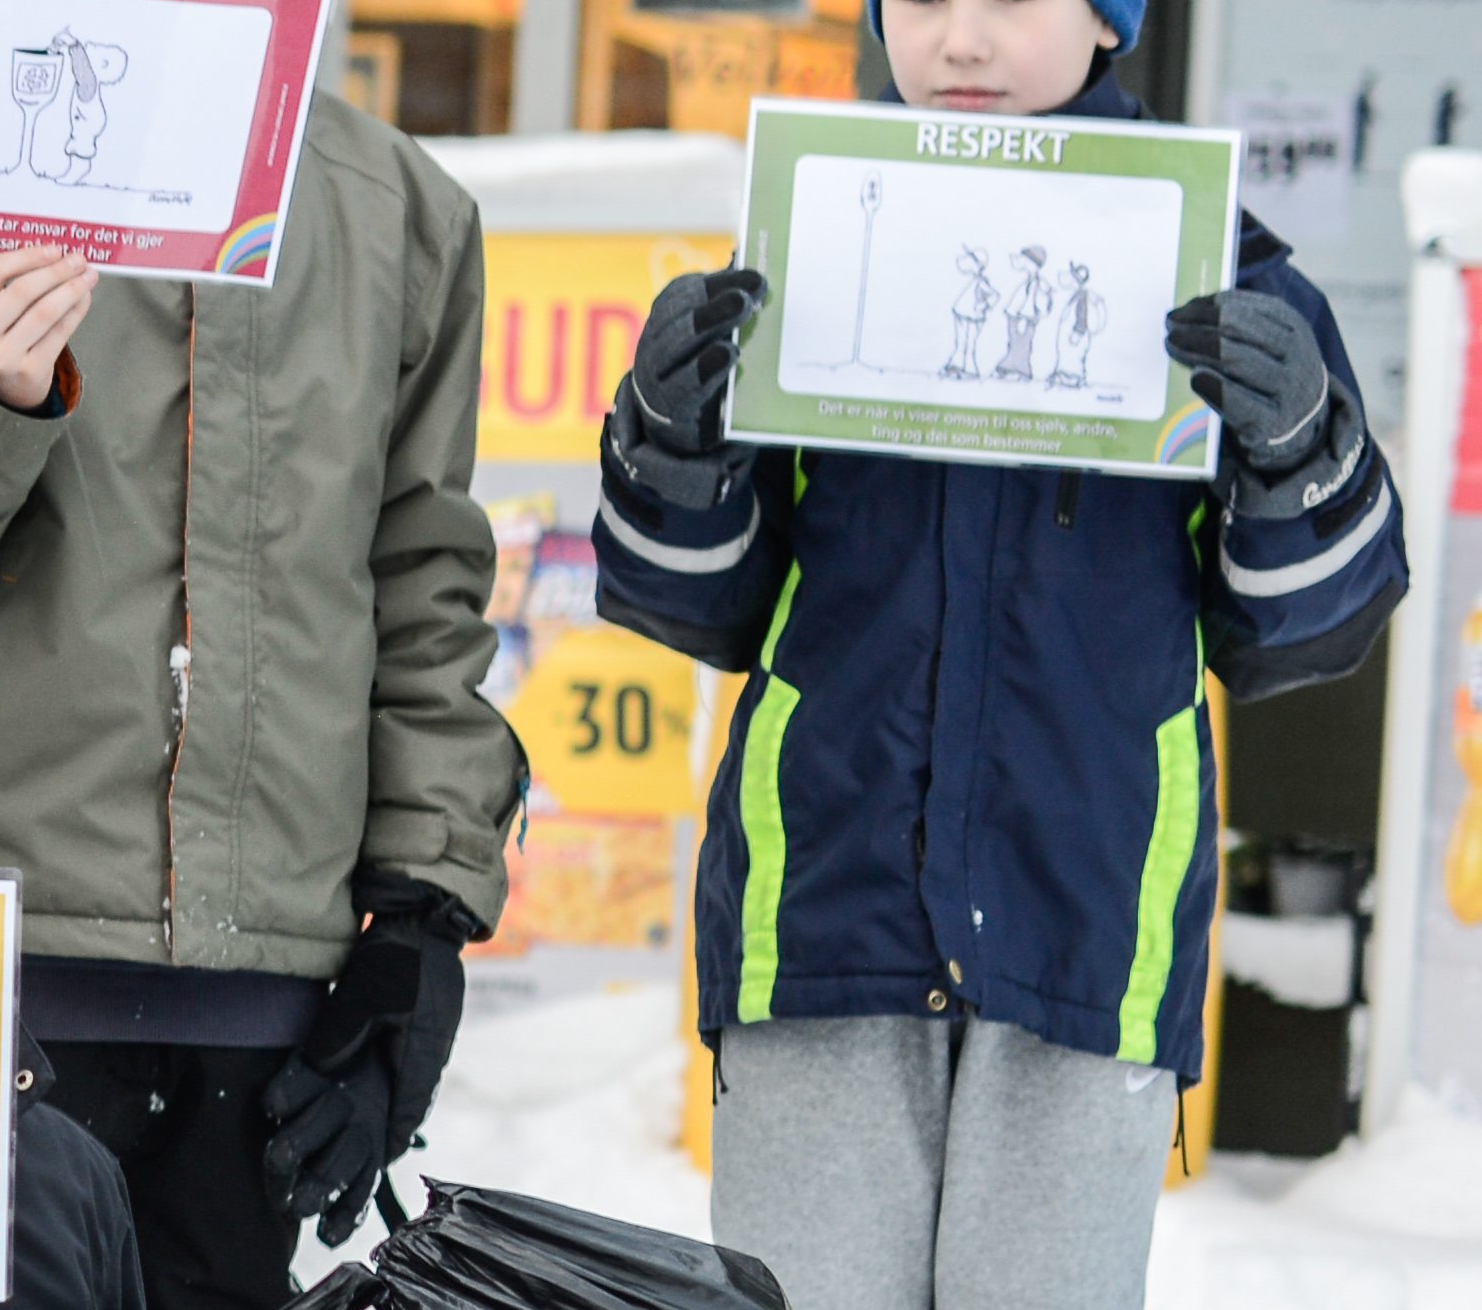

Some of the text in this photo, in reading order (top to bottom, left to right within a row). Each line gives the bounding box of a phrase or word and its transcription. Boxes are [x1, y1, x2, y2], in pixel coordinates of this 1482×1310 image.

[917, 123, 1070, 164] RESPEKT
[21, 221, 66, 237] ansvar
[70, 224, 90, 239] for
[95, 227, 118, 243] det
[121, 230, 133, 245] vi
[137, 232, 164, 249] gjer
[89, 245, 112, 261] har
[480, 302, 645, 421] UD
[819, 400, 843, 415] Det
[847, 404, 861, 416] er
[866, 403, 889, 418] når
[893, 406, 905, 419] vi
[909, 407, 940, 423] viser
[944, 413, 989, 431] omsyn
[993, 415, 1007, 428] til
[1011, 418, 1032, 431] oss
[872, 425, 1062, 452] ting og dei som bestemmer
